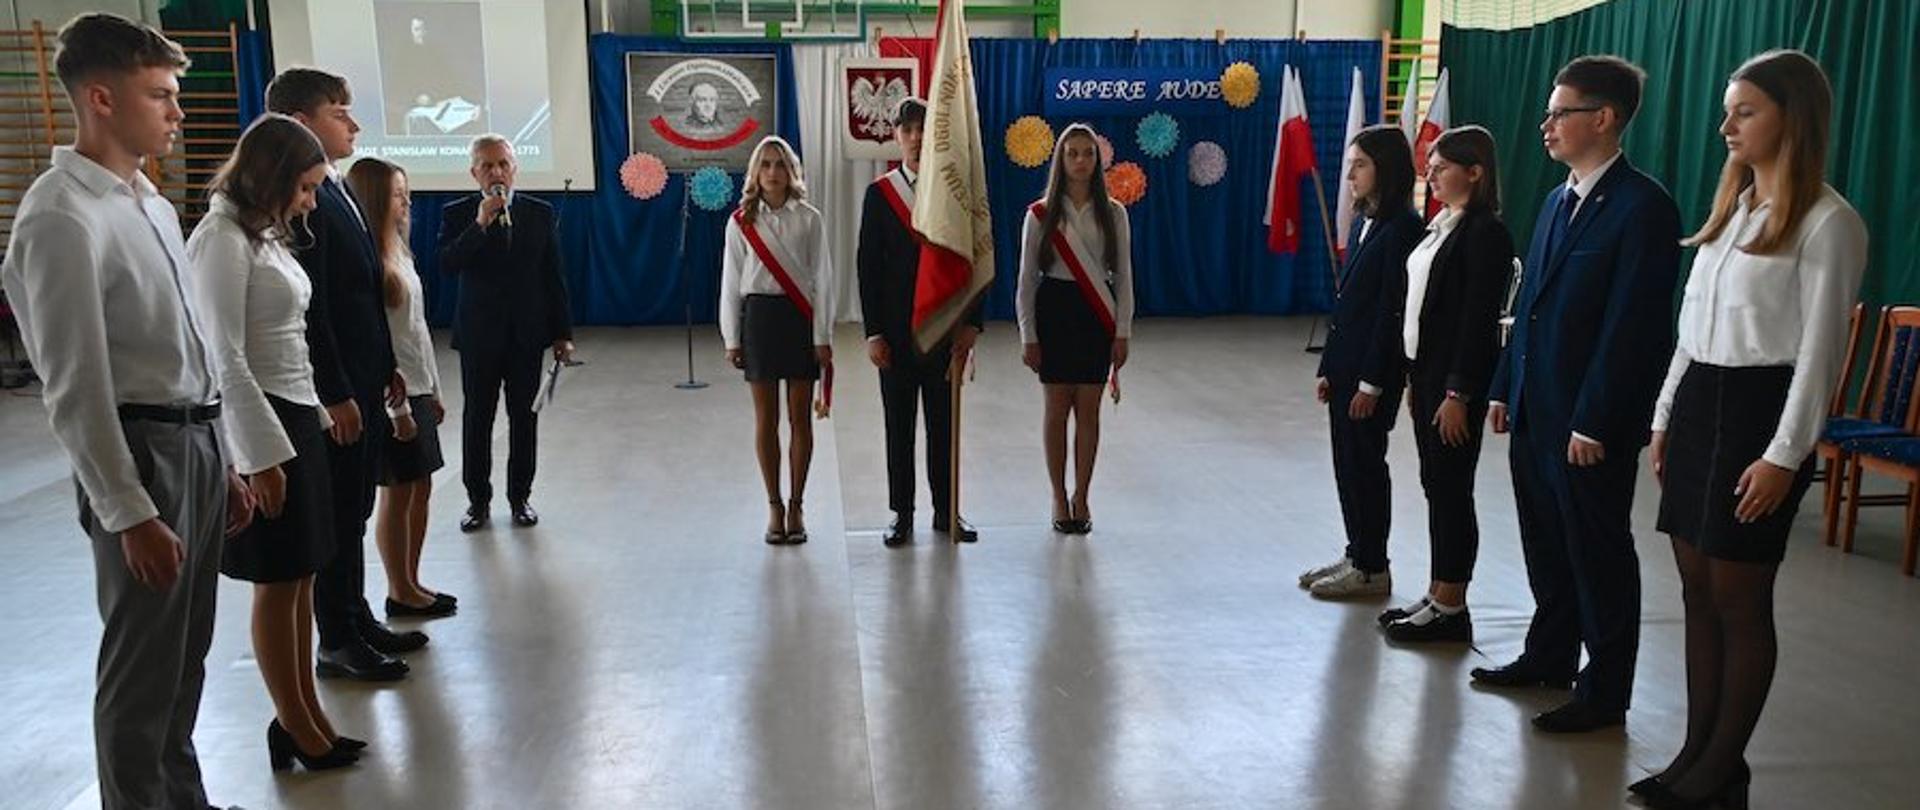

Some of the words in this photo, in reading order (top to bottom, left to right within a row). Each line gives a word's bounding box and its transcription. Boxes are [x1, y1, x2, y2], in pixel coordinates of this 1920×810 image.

[1055, 79, 1146, 101] SAPERE
[1155, 79, 1222, 101] AUDE
[439, 146, 471, 156] KONA
